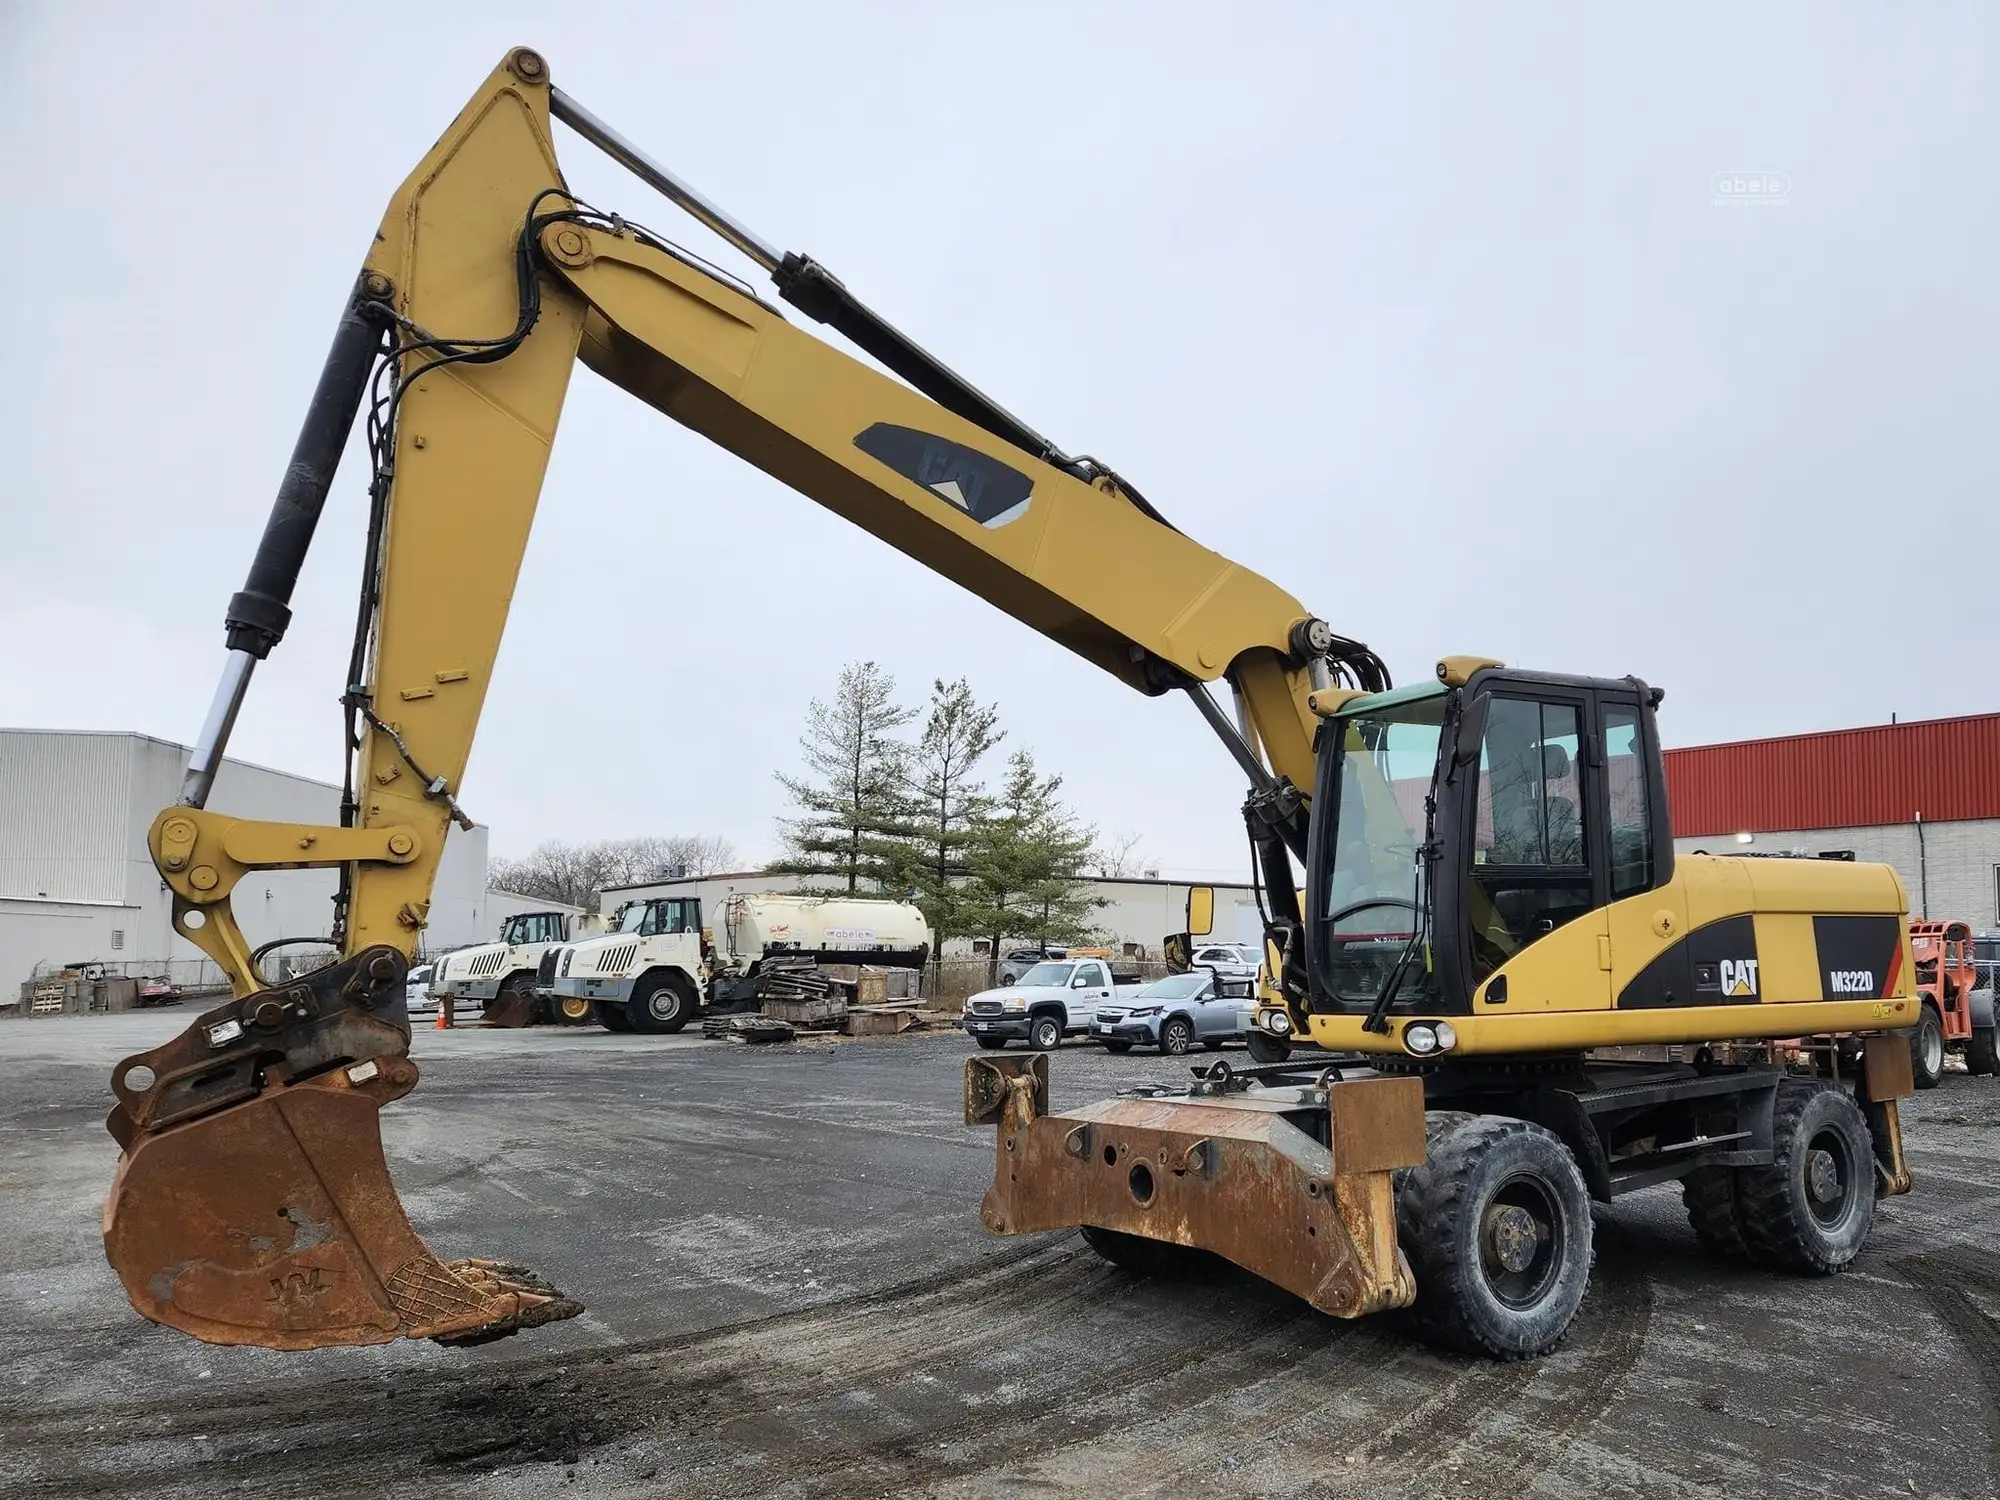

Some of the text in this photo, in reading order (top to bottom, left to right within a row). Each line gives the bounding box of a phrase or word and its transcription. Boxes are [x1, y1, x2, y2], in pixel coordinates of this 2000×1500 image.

[836, 930, 864, 938] abele
[1719, 959, 1758, 996] CAT
[1830, 971, 1874, 993] M322D
